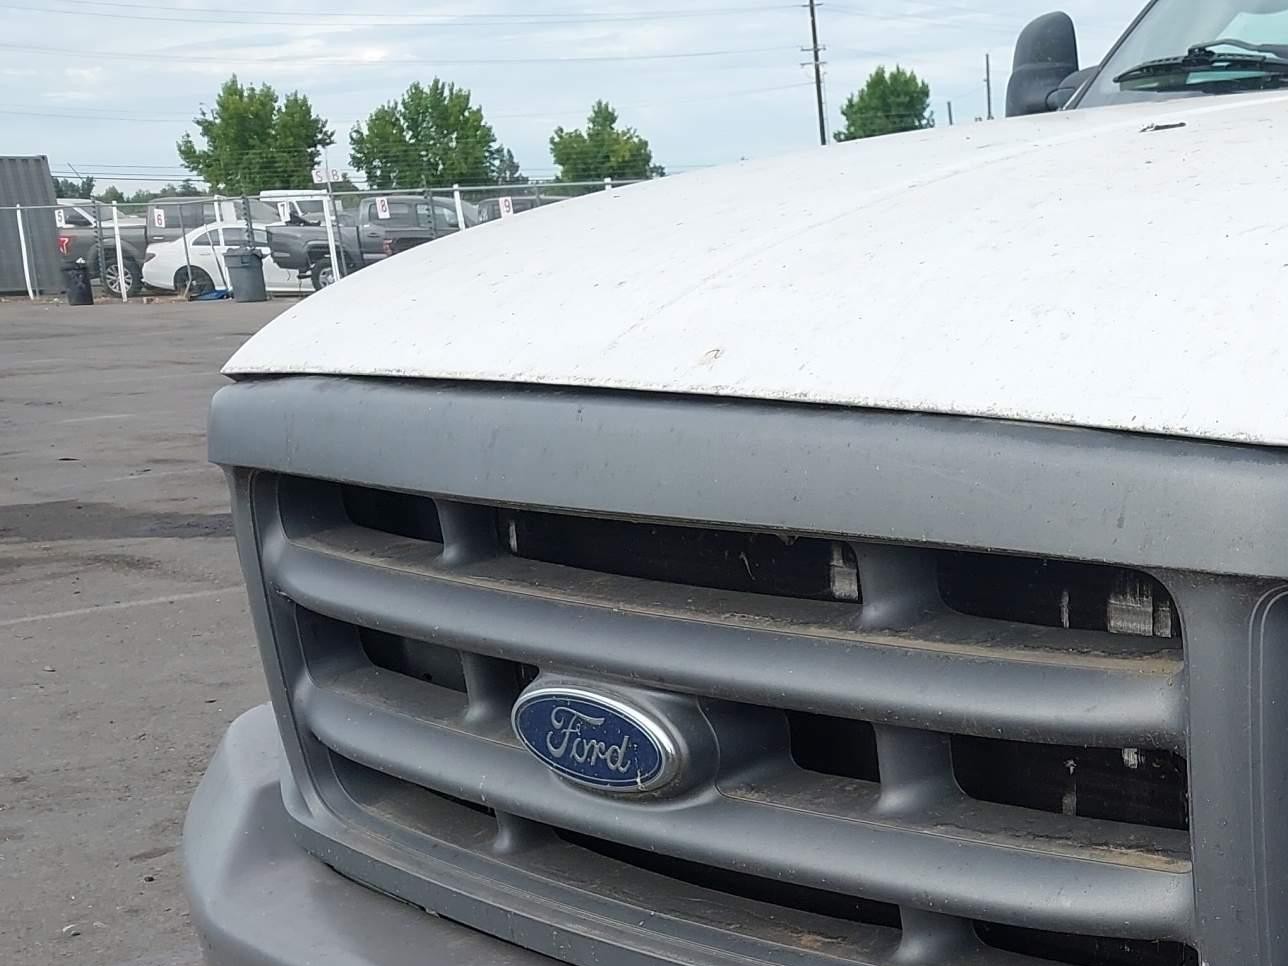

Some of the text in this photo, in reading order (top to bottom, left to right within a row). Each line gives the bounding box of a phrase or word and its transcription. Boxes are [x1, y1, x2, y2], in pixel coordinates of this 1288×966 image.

[280, 203, 286, 217] 7
[380, 199, 388, 213] 8
[503, 198, 511, 213] 9
[156, 213, 163, 226] 6
[546, 706, 631, 773] Ford
